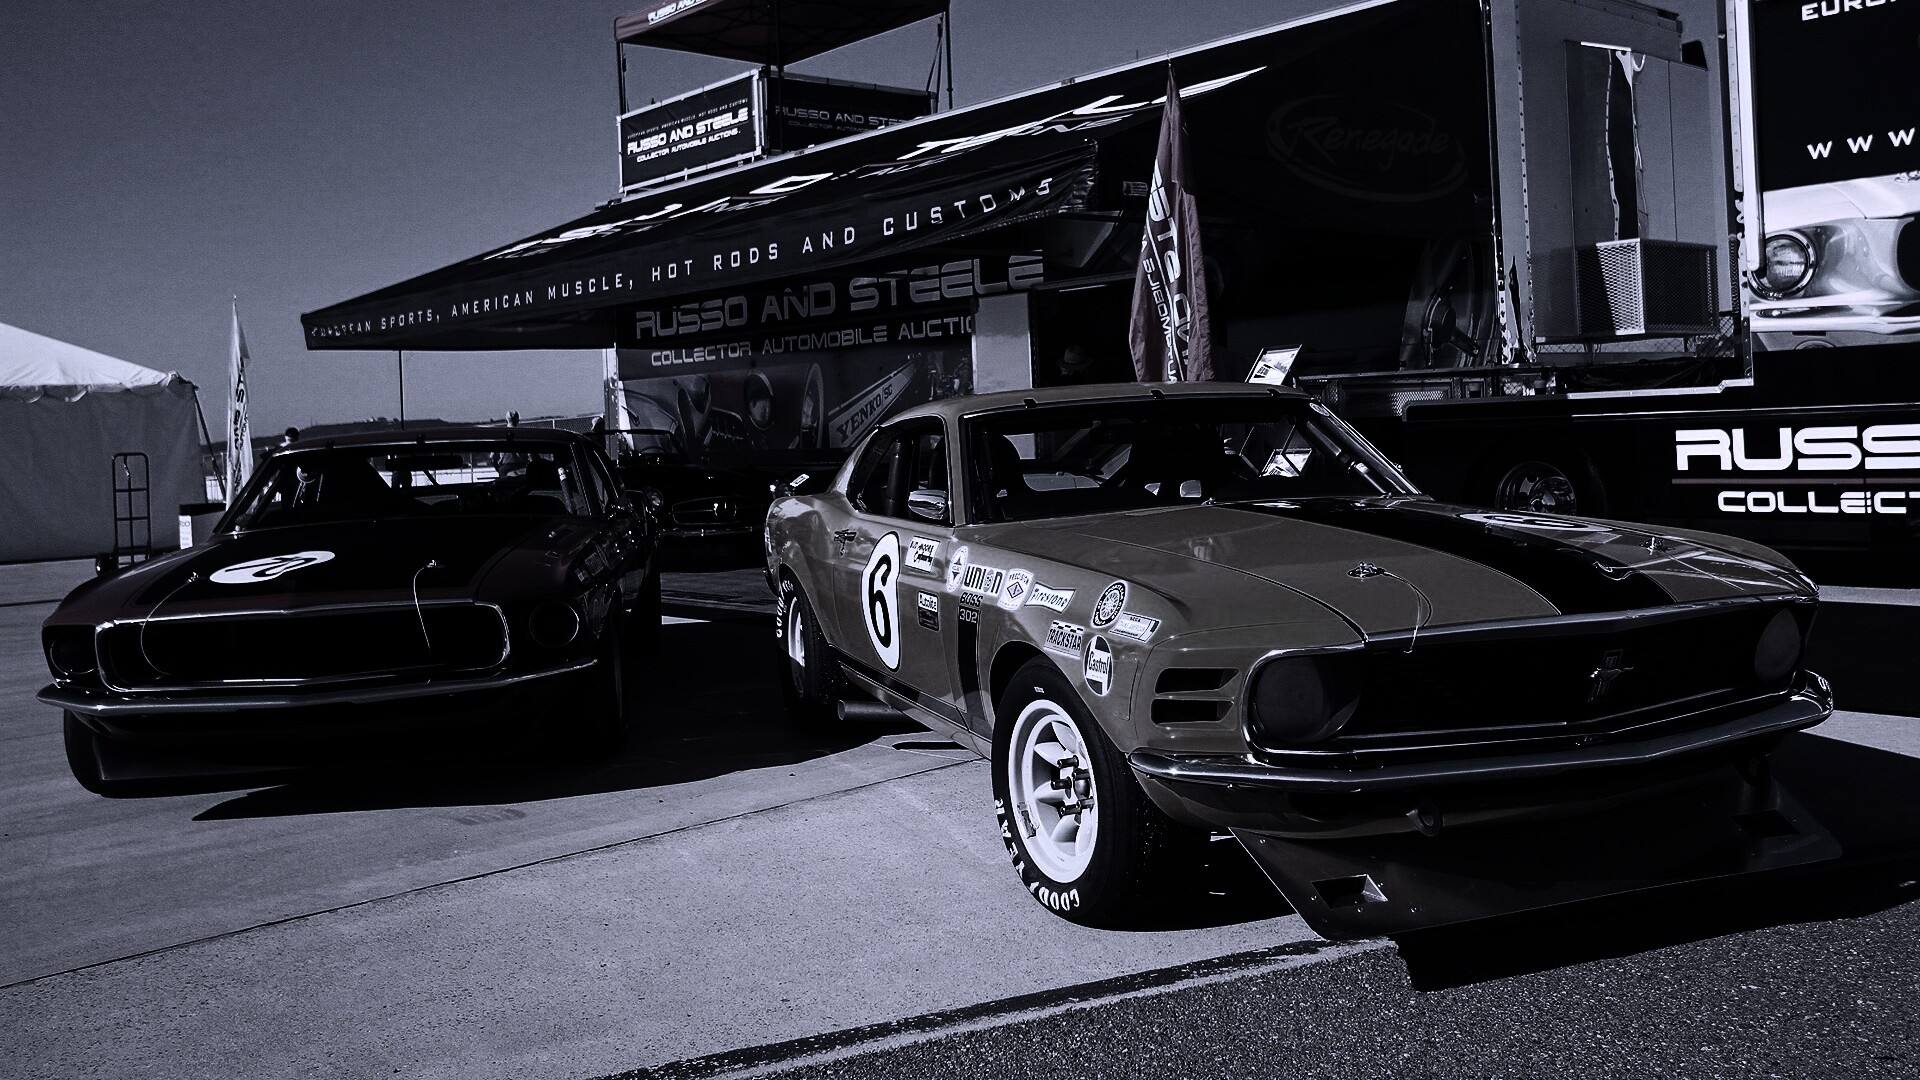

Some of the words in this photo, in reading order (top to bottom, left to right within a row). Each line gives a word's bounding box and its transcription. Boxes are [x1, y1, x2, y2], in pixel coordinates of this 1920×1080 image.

[1801, 0, 1897, 21] EUR
[774, 105, 830, 121] RUSSO
[834, 112, 865, 125] AND
[627, 132, 667, 156] RUSSO
[669, 124, 694, 143] AND
[695, 107, 749, 135] STEELE
[1287, 116, 1450, 172] Renegade
[636, 147, 670, 163] COLLECTOR
[671, 136, 707, 153] AUTOMOBILE
[380, 308, 440, 329] SPORTS,
[451, 290, 533, 317] AMERICAN
[547, 273, 633, 300] MUSCLE,
[651, 259, 693, 282] HOT
[713, 243, 779, 271] RODS
[802, 226, 856, 254] AND
[883, 177, 1053, 236] CUSTOMS
[636, 295, 748, 340] RUSSO
[760, 281, 836, 324] AND
[848, 249, 1045, 312] STEELE
[651, 341, 752, 367] COLLECTOR
[762, 324, 888, 355] AUTOMOBILE
[1675, 424, 1920, 471] RUSS
[868, 553, 892, 649] 6
[960, 592, 984, 608] BOSS
[1031, 588, 1068, 608] Firestone
[959, 608, 979, 624] 302
[1046, 628, 1082, 651] TRACKSTAR
[1088, 650, 1110, 675] Castrol
